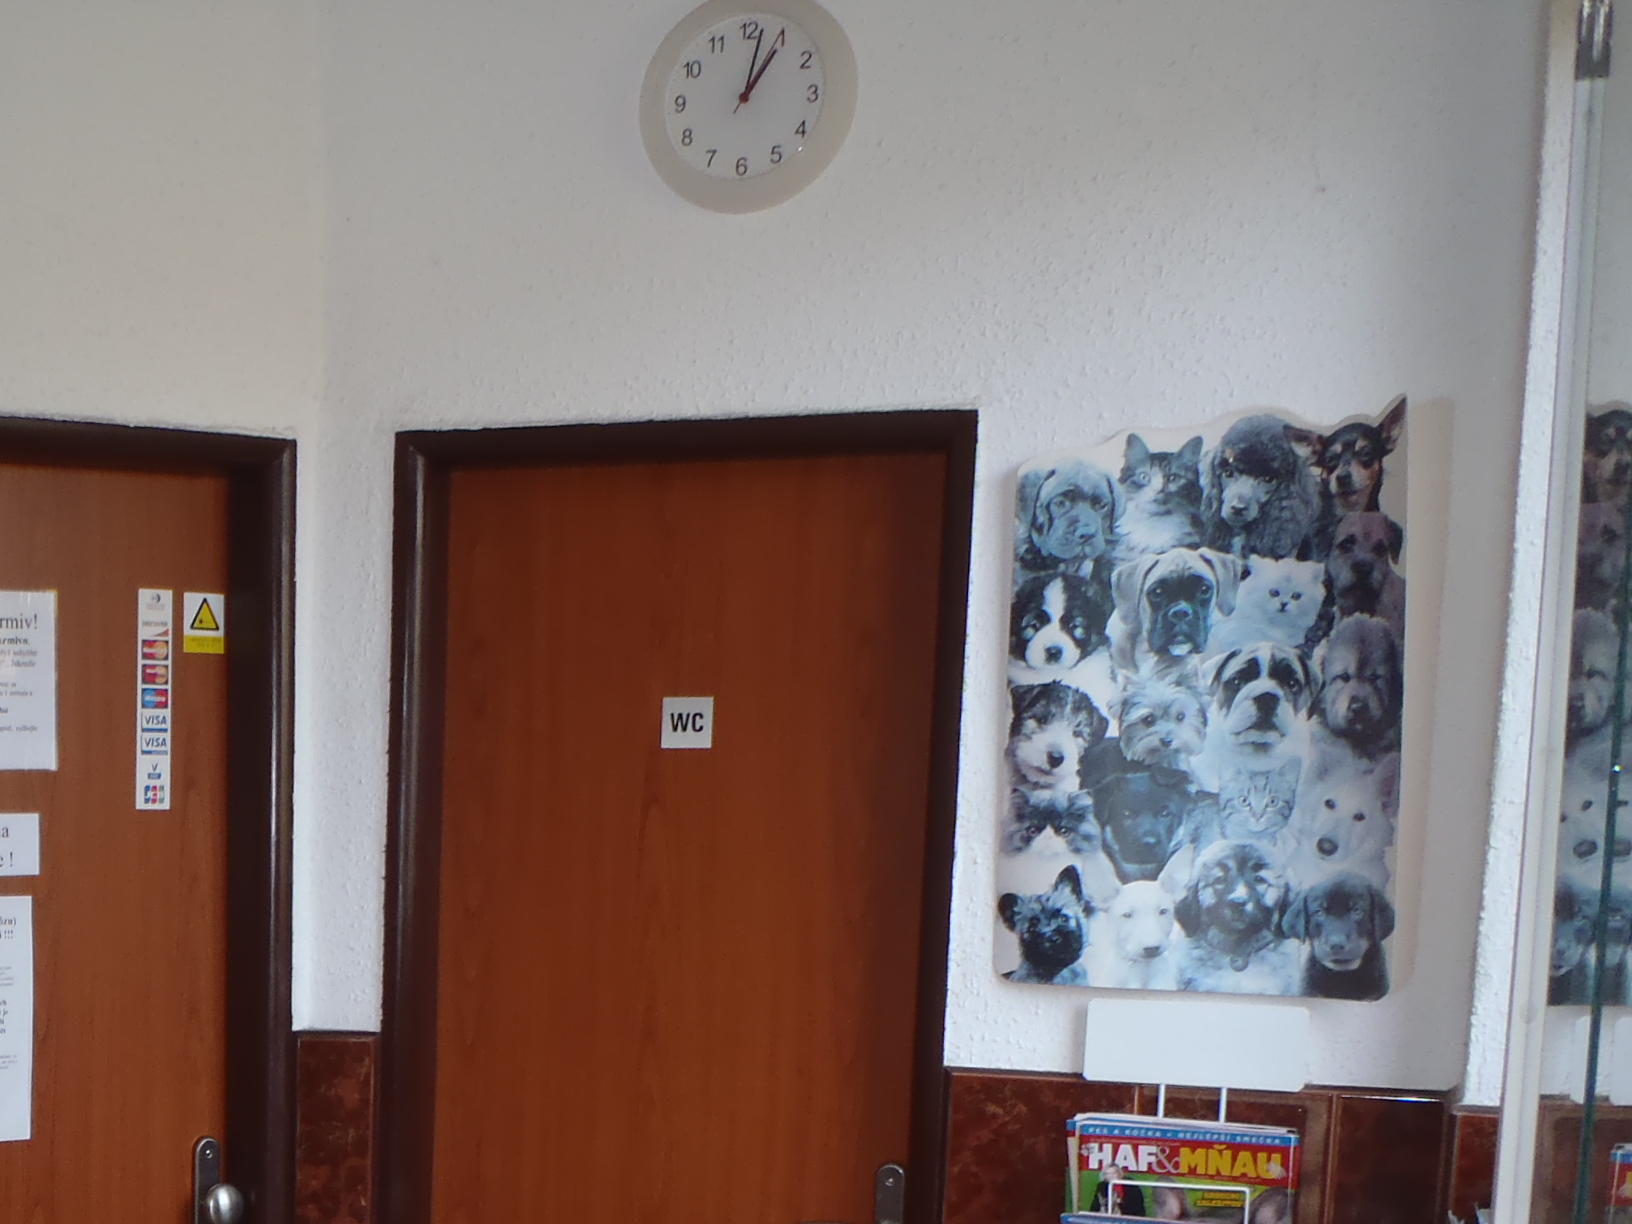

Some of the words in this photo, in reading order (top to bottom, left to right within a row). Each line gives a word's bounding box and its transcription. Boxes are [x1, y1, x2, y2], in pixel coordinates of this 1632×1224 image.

[739, 21, 759, 40] 12
[708, 35, 725, 53] 11
[683, 60, 702, 79] 10
[800, 51, 812, 69] 2
[807, 84, 819, 103] 3
[675, 95, 686, 113] 9
[681, 128, 693, 147] 8
[794, 120, 806, 138] 4
[706, 149, 718, 168] 7
[770, 145, 783, 164] 5
[735, 157, 748, 176] 6
[144, 715, 167, 726] VISA
[670, 712, 704, 733] WC
[144, 737, 167, 748] VISA
